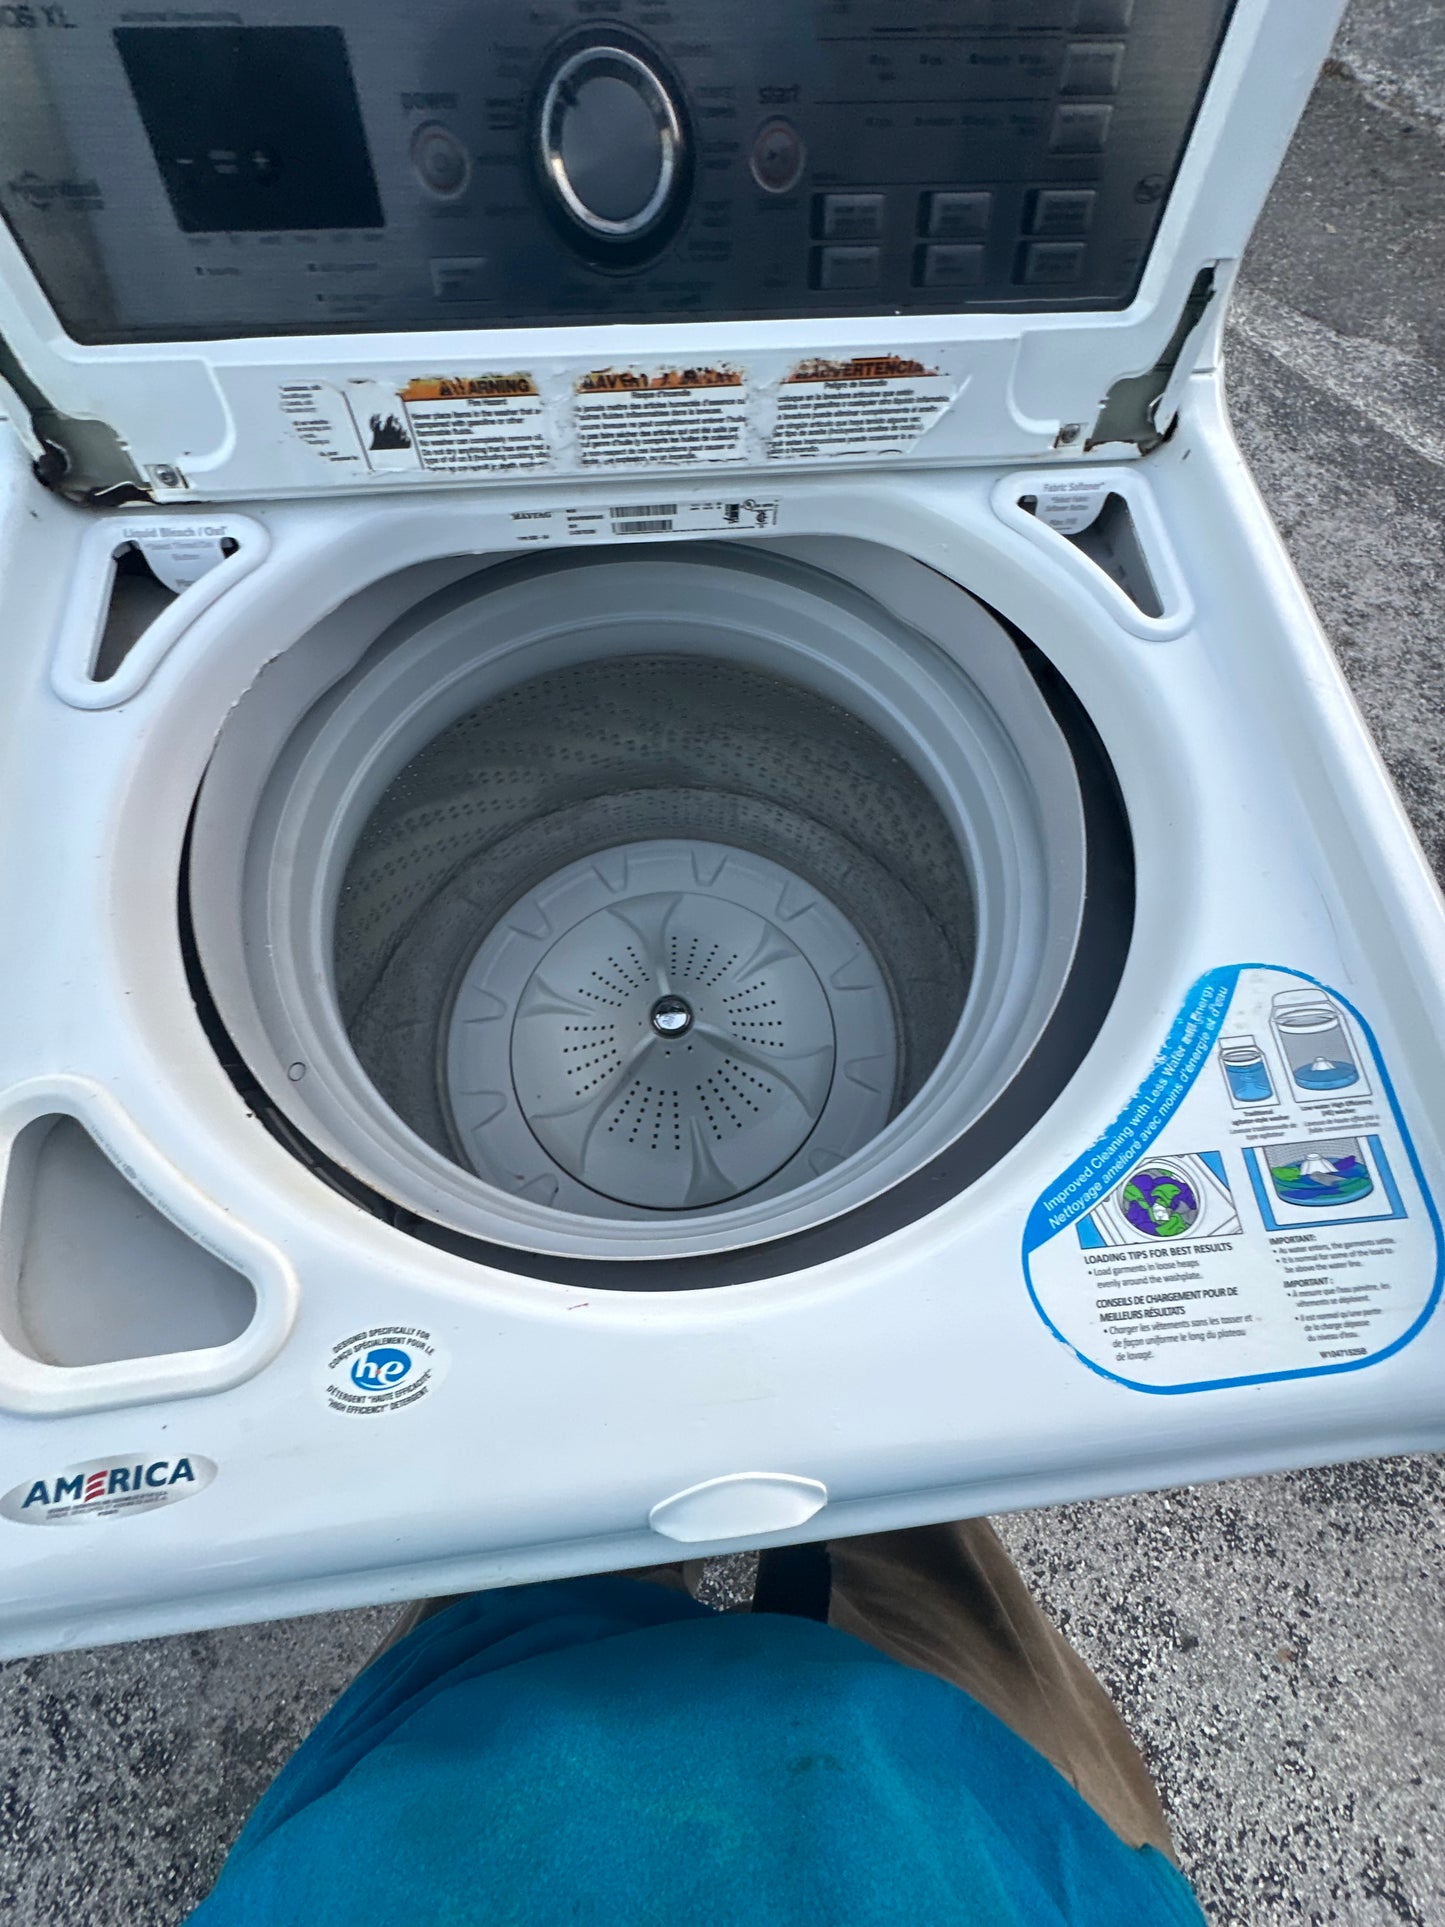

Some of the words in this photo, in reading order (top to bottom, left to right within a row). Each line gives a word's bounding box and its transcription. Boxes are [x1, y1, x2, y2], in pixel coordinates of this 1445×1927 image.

[1208, 985, 1228, 1017] d'eau
[1206, 1018, 1216, 1031] et
[1043, 1166, 1094, 1211] Improved
[1090, 1126, 1135, 1169] Cleaning
[1130, 1103, 1150, 1126] with
[1145, 1078, 1168, 1103] Less
[1162, 1045, 1186, 1076] Water
[1190, 985, 1215, 1024] Energy
[1158, 1082, 1184, 1117] moins
[1139, 1115, 1162, 1142] avec
[1048, 1181, 1103, 1229] Nettoyage
[1269, 1234, 1317, 1245] IMPORTANT:
[1084, 1252, 1127, 1264] LOADING
[1128, 1249, 1148, 1260] TIPS
[1150, 1247, 1168, 1258] FOR
[1171, 1245, 1192, 1256] BEST
[1194, 1242, 1233, 1254] RESULTS
[1093, 1267, 1112, 1277] Load
[1113, 1264, 1147, 1277] garments
[1147, 1262, 1154, 1271] in
[1155, 1261, 1176, 1270] loose
[1177, 1259, 1200, 1270] heaps
[1097, 1279, 1121, 1289] evenly
[1122, 1276, 1149, 1286] around
[1150, 1275, 1163, 1284] the
[1096, 1296, 1133, 1309] CONSEILS
[1134, 1296, 1144, 1305] DE
[1145, 1290, 1201, 1303] CHARGEMENT
[1203, 1288, 1225, 1298] POUR
[1226, 1286, 1238, 1296] DE
[1100, 1309, 1143, 1322] MEILLEURS
[1144, 1305, 1186, 1318] RÉSULTATS
[1109, 1325, 1139, 1335] Charger
[1139, 1323, 1151, 1332] les
[1151, 1320, 1190, 1330] vêtements
[1191, 1318, 1209, 1327] sans
[1208, 1317, 1220, 1325] les
[1244, 1314, 1253, 1323] et
[333, 1332, 367, 1353] DESIGNED
[369, 1327, 416, 1337] SPECIFICALLY
[416, 1329, 430, 1340] FOR
[407, 1338, 426, 1350] POUR
[425, 1345, 435, 1356] LE
[1112, 1339, 1123, 1348] de
[1123, 1337, 1144, 1348] façon
[1146, 1334, 1179, 1346] uniforme
[1180, 1333, 1187, 1342] le
[1188, 1331, 1205, 1342] long
[1206, 1330, 1217, 1339] du
[1217, 1328, 1246, 1340] plateau
[1116, 1352, 1126, 1362] de
[355, 1353, 405, 1385] he
[390, 1386, 428, 1410] DETERGENT
[21, 1458, 196, 1509] AMERICA
